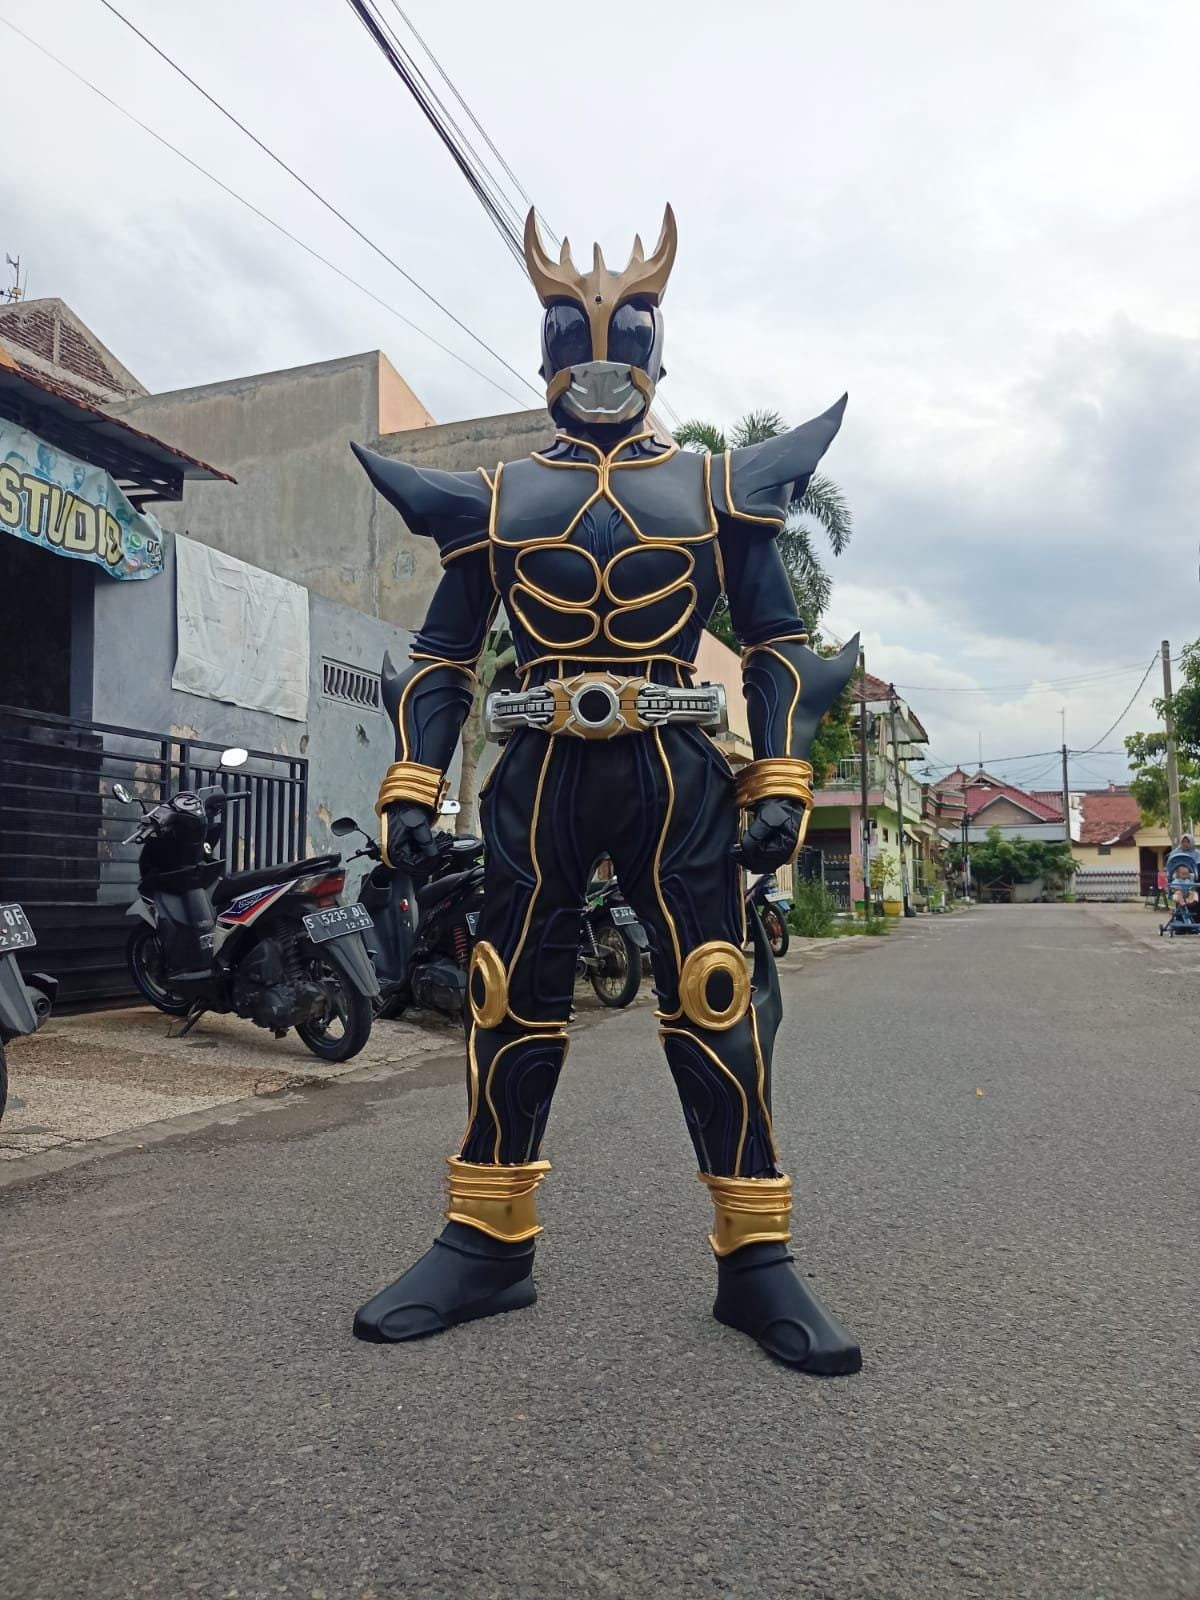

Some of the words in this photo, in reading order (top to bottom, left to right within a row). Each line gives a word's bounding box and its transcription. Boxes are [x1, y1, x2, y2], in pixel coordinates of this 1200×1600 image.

[305, 918, 315, 929] S
[321, 909, 348, 925] 5235
[468, 914, 476, 924] S
